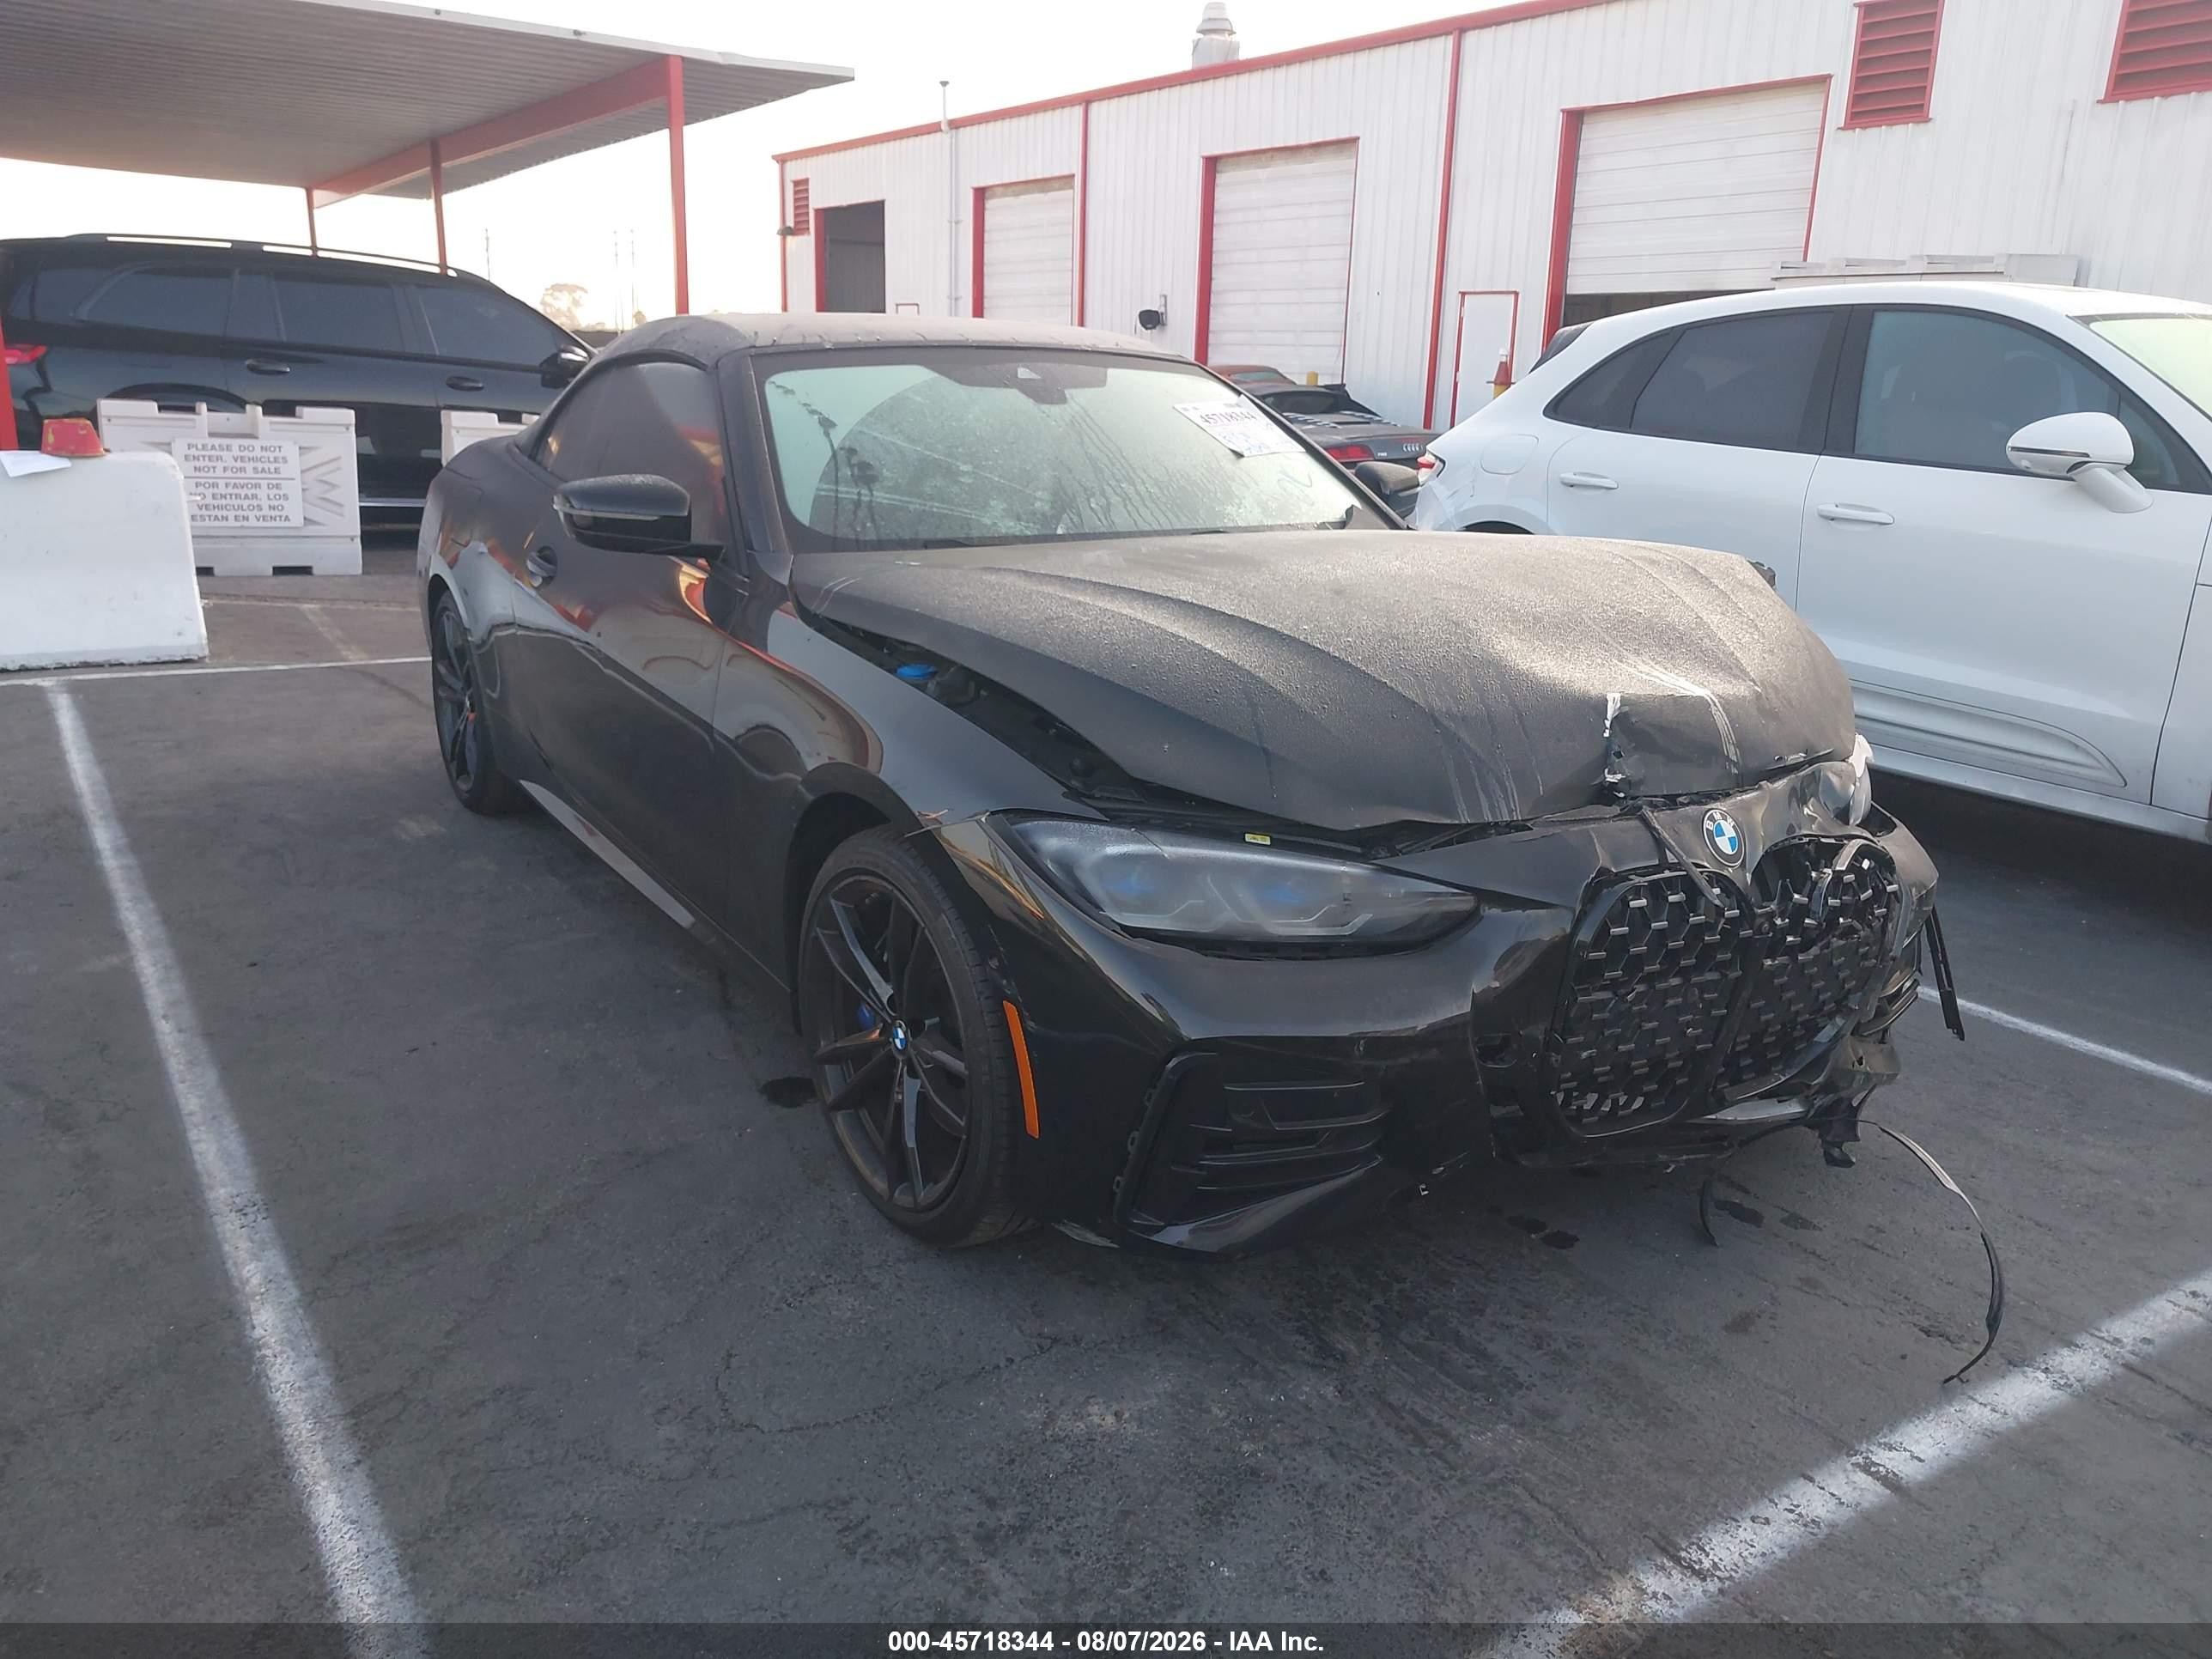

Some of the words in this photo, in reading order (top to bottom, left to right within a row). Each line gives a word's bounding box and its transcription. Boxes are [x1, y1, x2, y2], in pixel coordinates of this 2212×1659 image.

[187, 443, 233, 452] PLEASE
[238, 444, 255, 453] DO
[260, 445, 283, 453] NOT
[232, 455, 288, 464] VEHICLES
[193, 465, 217, 474] NOT
[222, 465, 246, 474] FOR
[195, 481, 219, 490] POR
[225, 482, 261, 490] FAVOR
[267, 483, 283, 491] DE
[267, 493, 289, 501] LOS
[197, 503, 263, 512] VEHICULOS
[268, 503, 284, 512] NO
[191, 514, 228, 523] ESTAN
[234, 514, 249, 523] EN
[255, 514, 291, 523] VENTA
[1705, 811, 1735, 831] BMW
